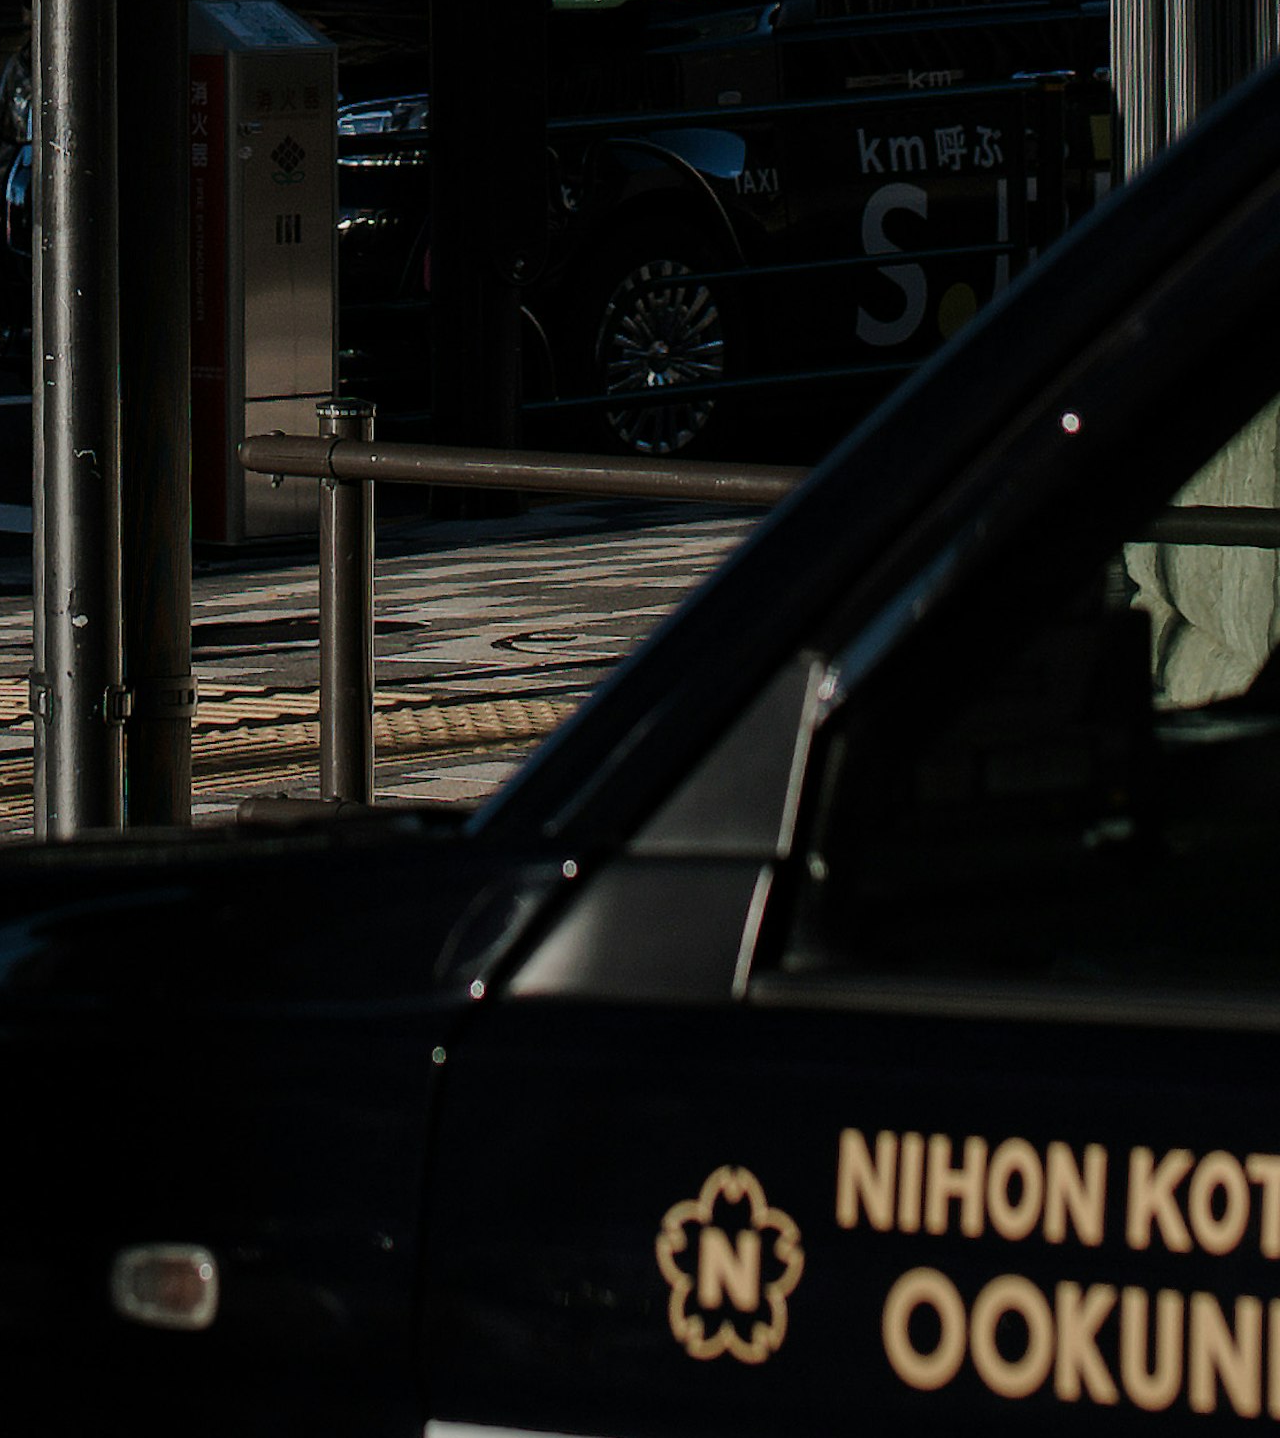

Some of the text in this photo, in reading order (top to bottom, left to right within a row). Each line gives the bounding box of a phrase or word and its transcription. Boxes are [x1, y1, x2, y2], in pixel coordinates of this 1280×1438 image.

[191, 80, 209, 169] 消火器
[835, 1126, 1109, 1249] NIHON
[696, 1225, 762, 1314] N
